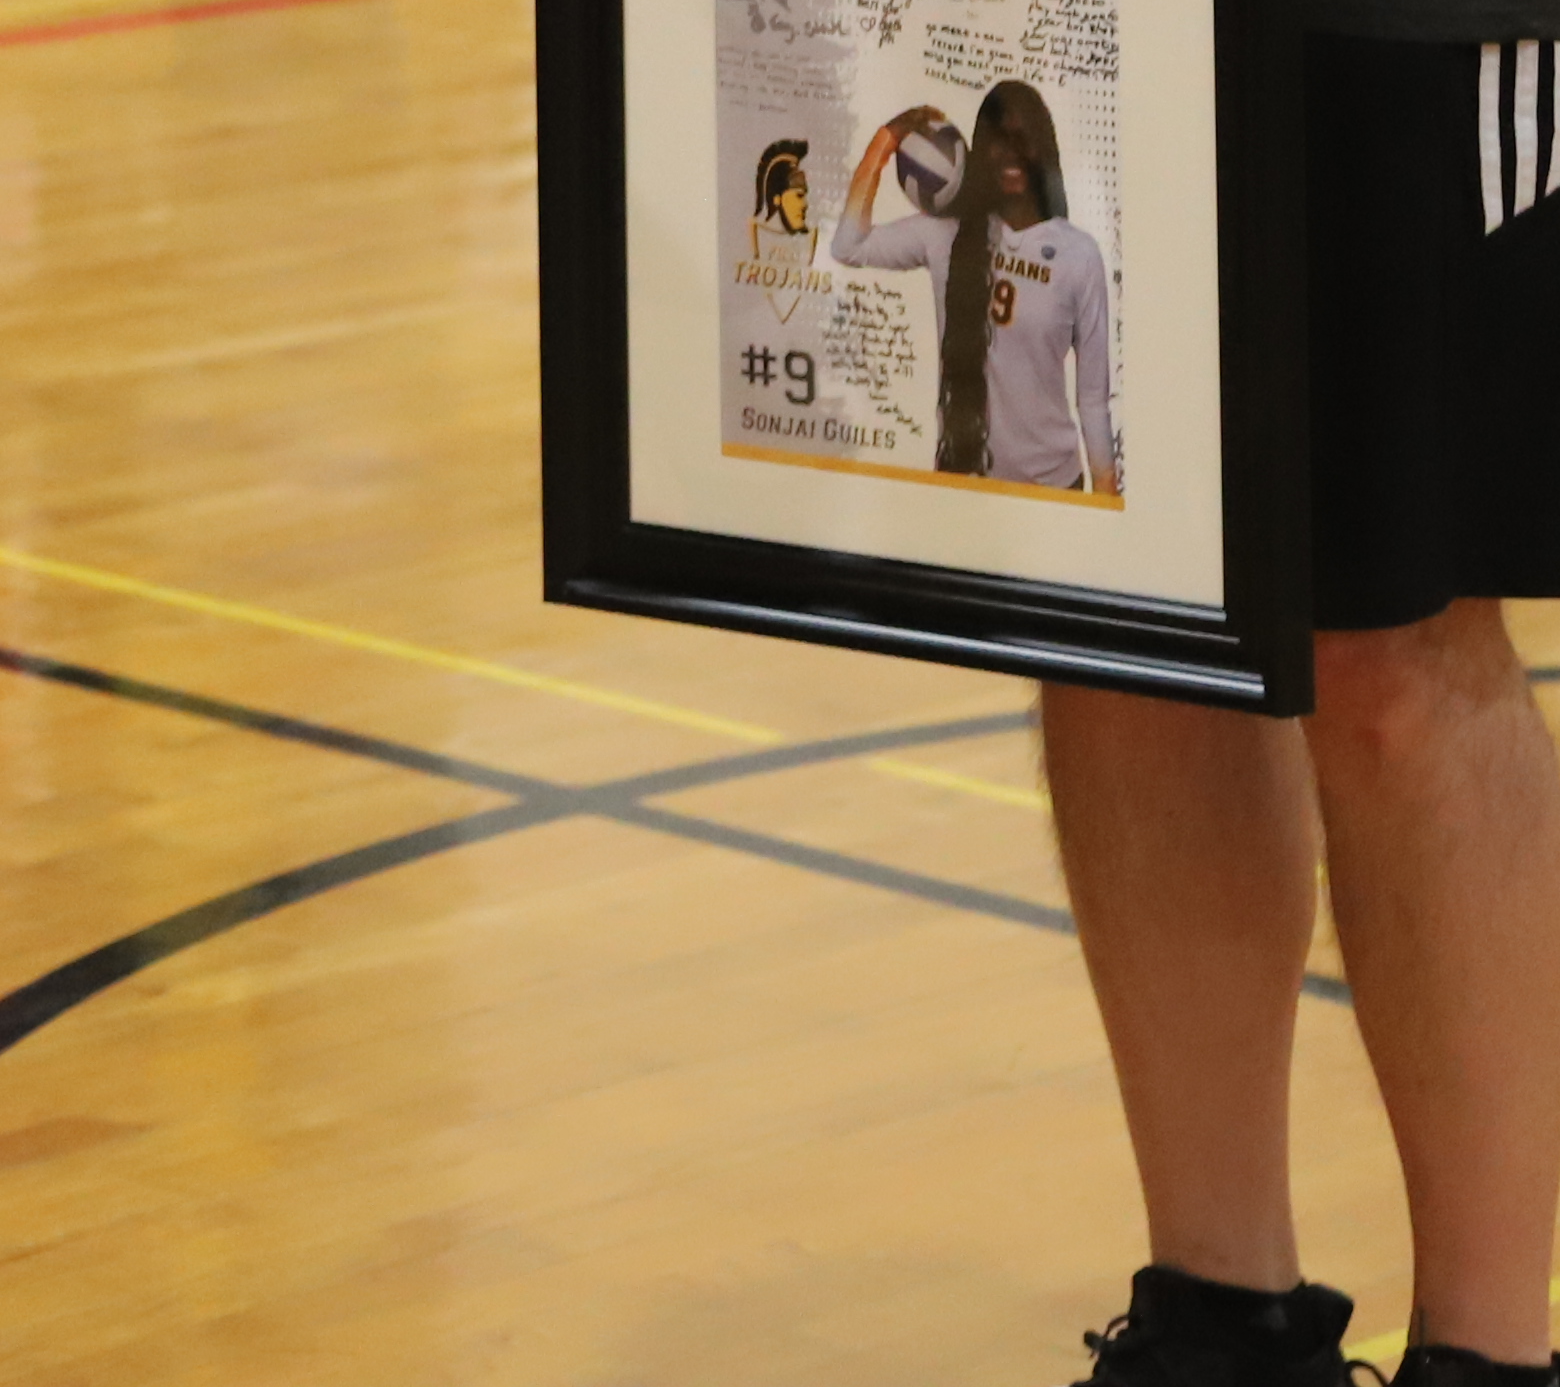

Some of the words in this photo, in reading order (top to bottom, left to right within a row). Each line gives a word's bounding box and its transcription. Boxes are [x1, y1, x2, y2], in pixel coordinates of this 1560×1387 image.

[735, 261, 832, 294] TROJANS
[991, 278, 1016, 327] 9
[741, 343, 816, 405] #9
